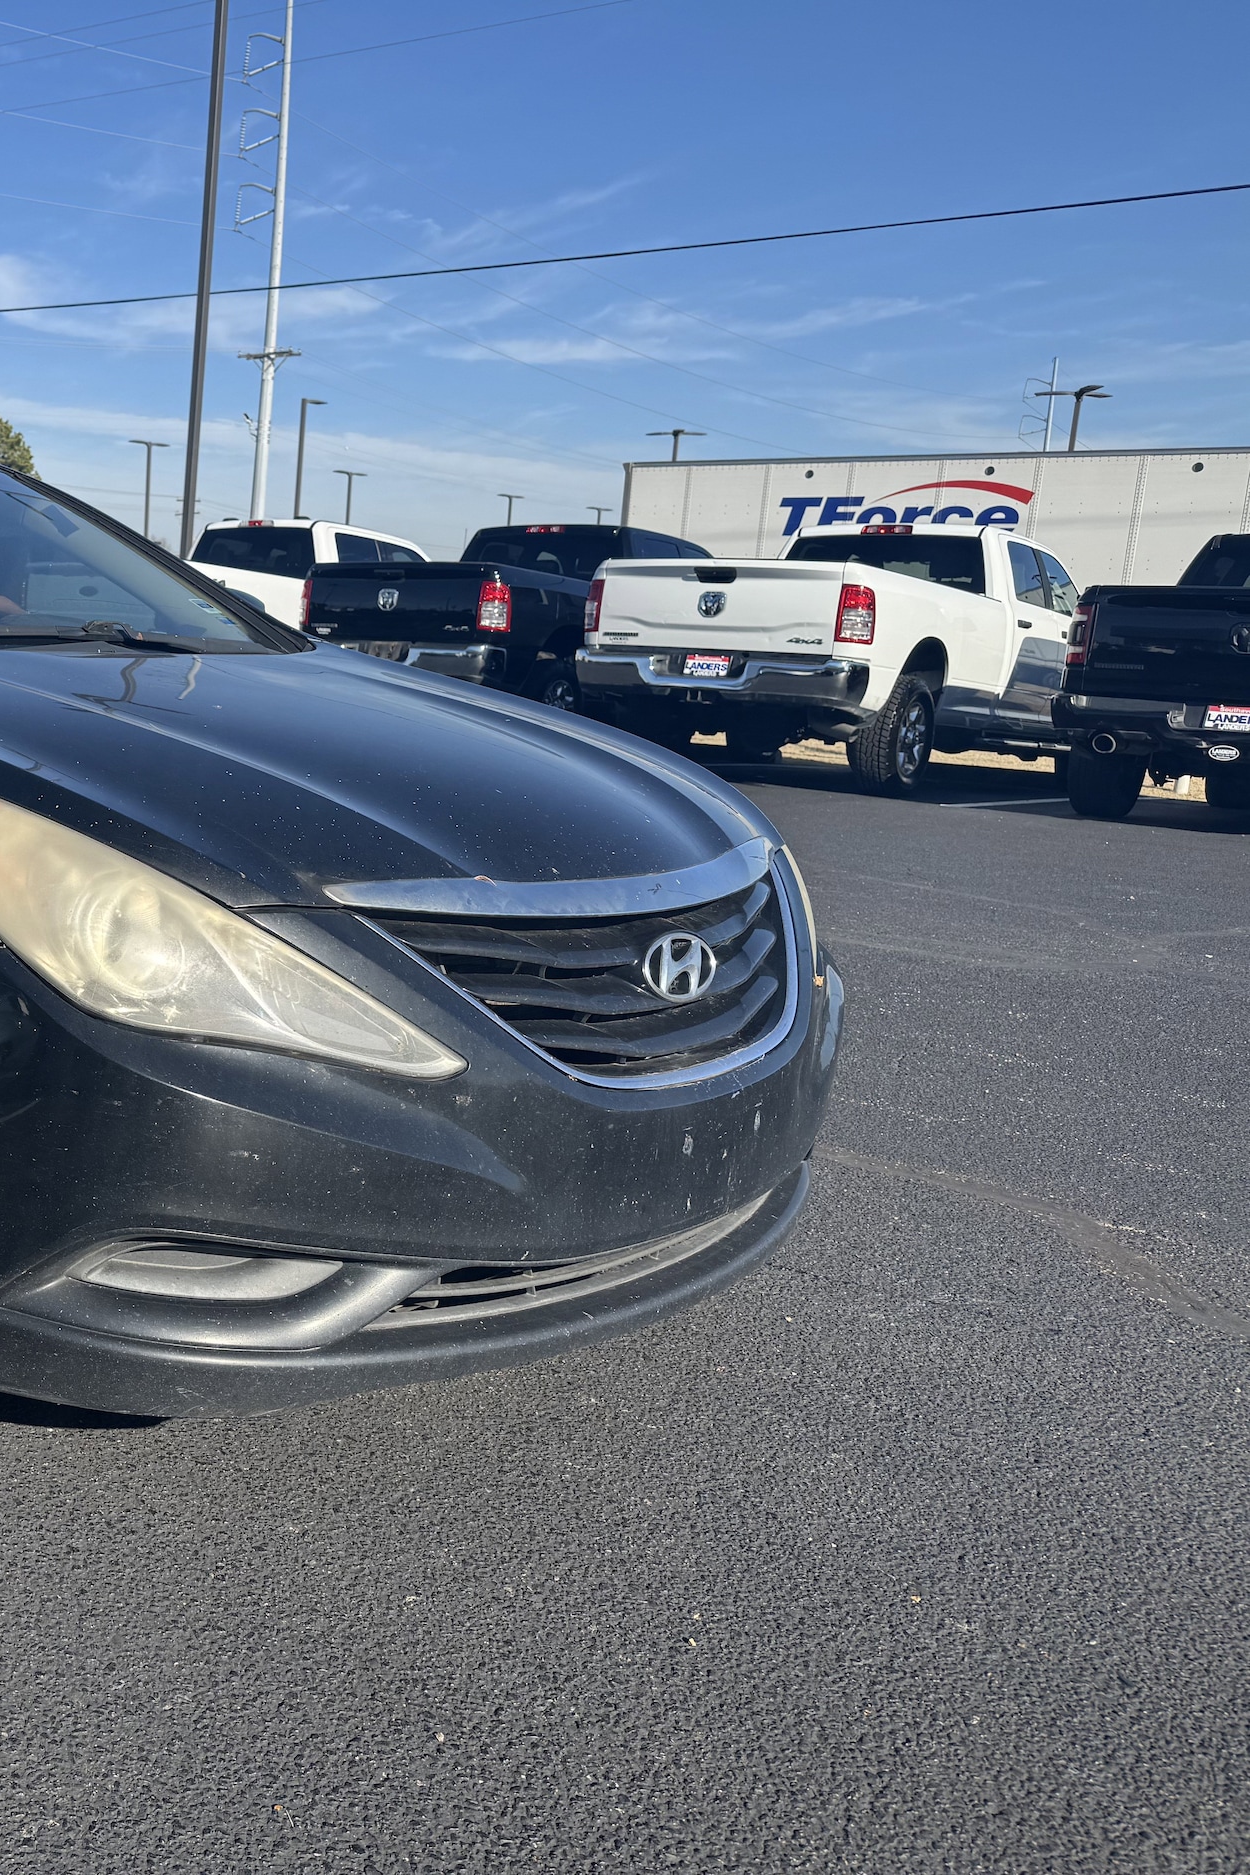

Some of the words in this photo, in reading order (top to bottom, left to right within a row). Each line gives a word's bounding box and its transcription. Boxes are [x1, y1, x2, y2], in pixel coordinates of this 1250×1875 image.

[779, 496, 1020, 536] TForce
[686, 662, 728, 671] LANDERS
[1207, 713, 1250, 724] LANDE
